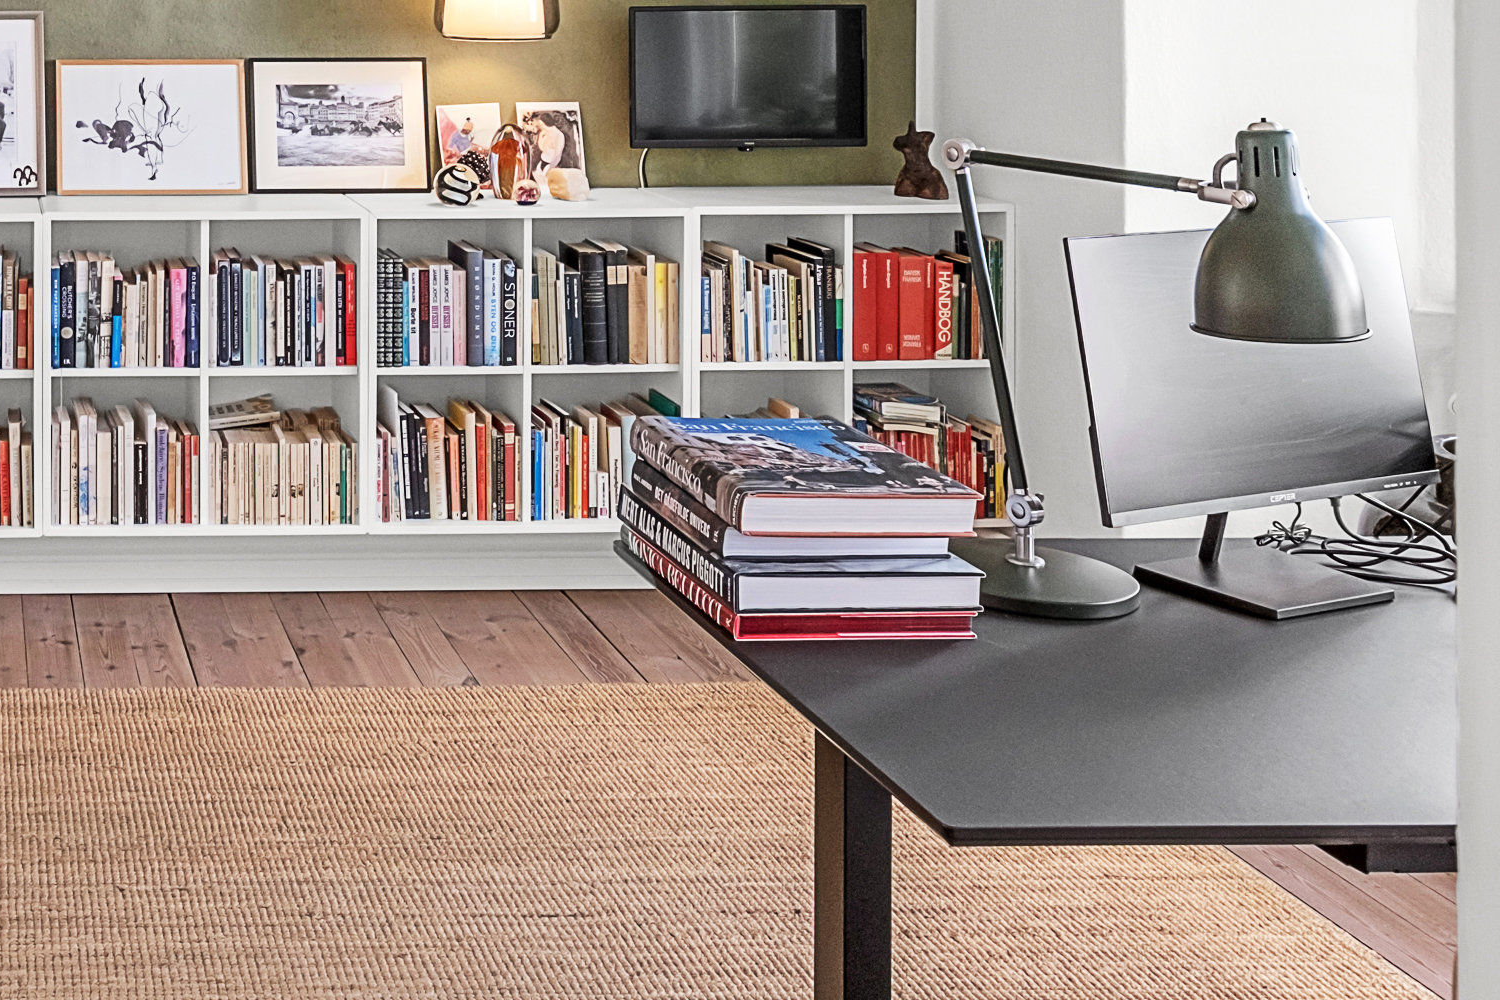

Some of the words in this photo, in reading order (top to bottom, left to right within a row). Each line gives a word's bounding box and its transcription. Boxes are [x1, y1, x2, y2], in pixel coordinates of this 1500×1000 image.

[490, 320, 498, 333] OG
[504, 282, 516, 339] STONER
[938, 271, 953, 343] HÅNDBOG
[490, 335, 498, 352] ØEN
[674, 421, 719, 431] San
[720, 422, 846, 432] Francisco
[639, 429, 656, 461] San
[657, 441, 701, 494] Francisco
[654, 486, 664, 503] DET
[689, 511, 711, 539] UNIVERS
[621, 493, 640, 527] MERT
[638, 507, 657, 541] ALAS
[655, 521, 663, 547] &
[662, 526, 692, 571] MARCUS
[691, 549, 725, 598] PIGGOTT
